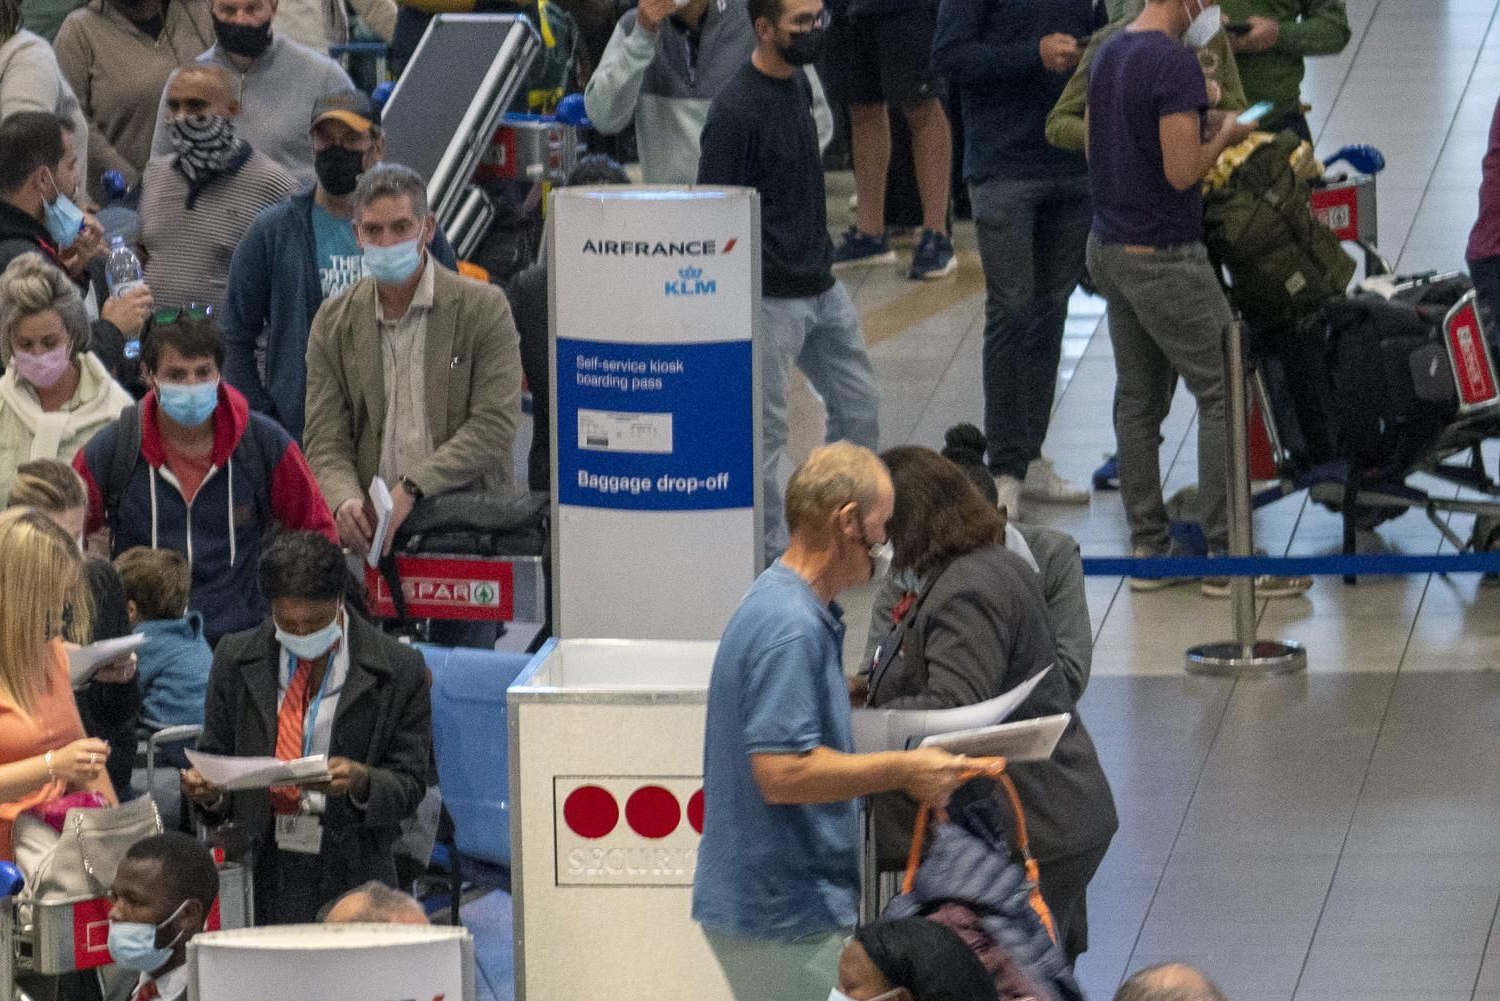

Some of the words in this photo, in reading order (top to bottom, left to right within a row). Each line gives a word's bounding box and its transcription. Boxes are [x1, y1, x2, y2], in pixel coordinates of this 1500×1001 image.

[582, 239, 716, 257] AIRFRANCE
[664, 280, 717, 297] KLM
[576, 354, 647, 373] Self-service
[650, 358, 685, 374] kiosk
[576, 372, 628, 391] boarding
[632, 376, 663, 392] pass
[578, 469, 651, 495] Baggage
[657, 472, 729, 494] drop-off
[401, 580, 469, 601] SPAR
